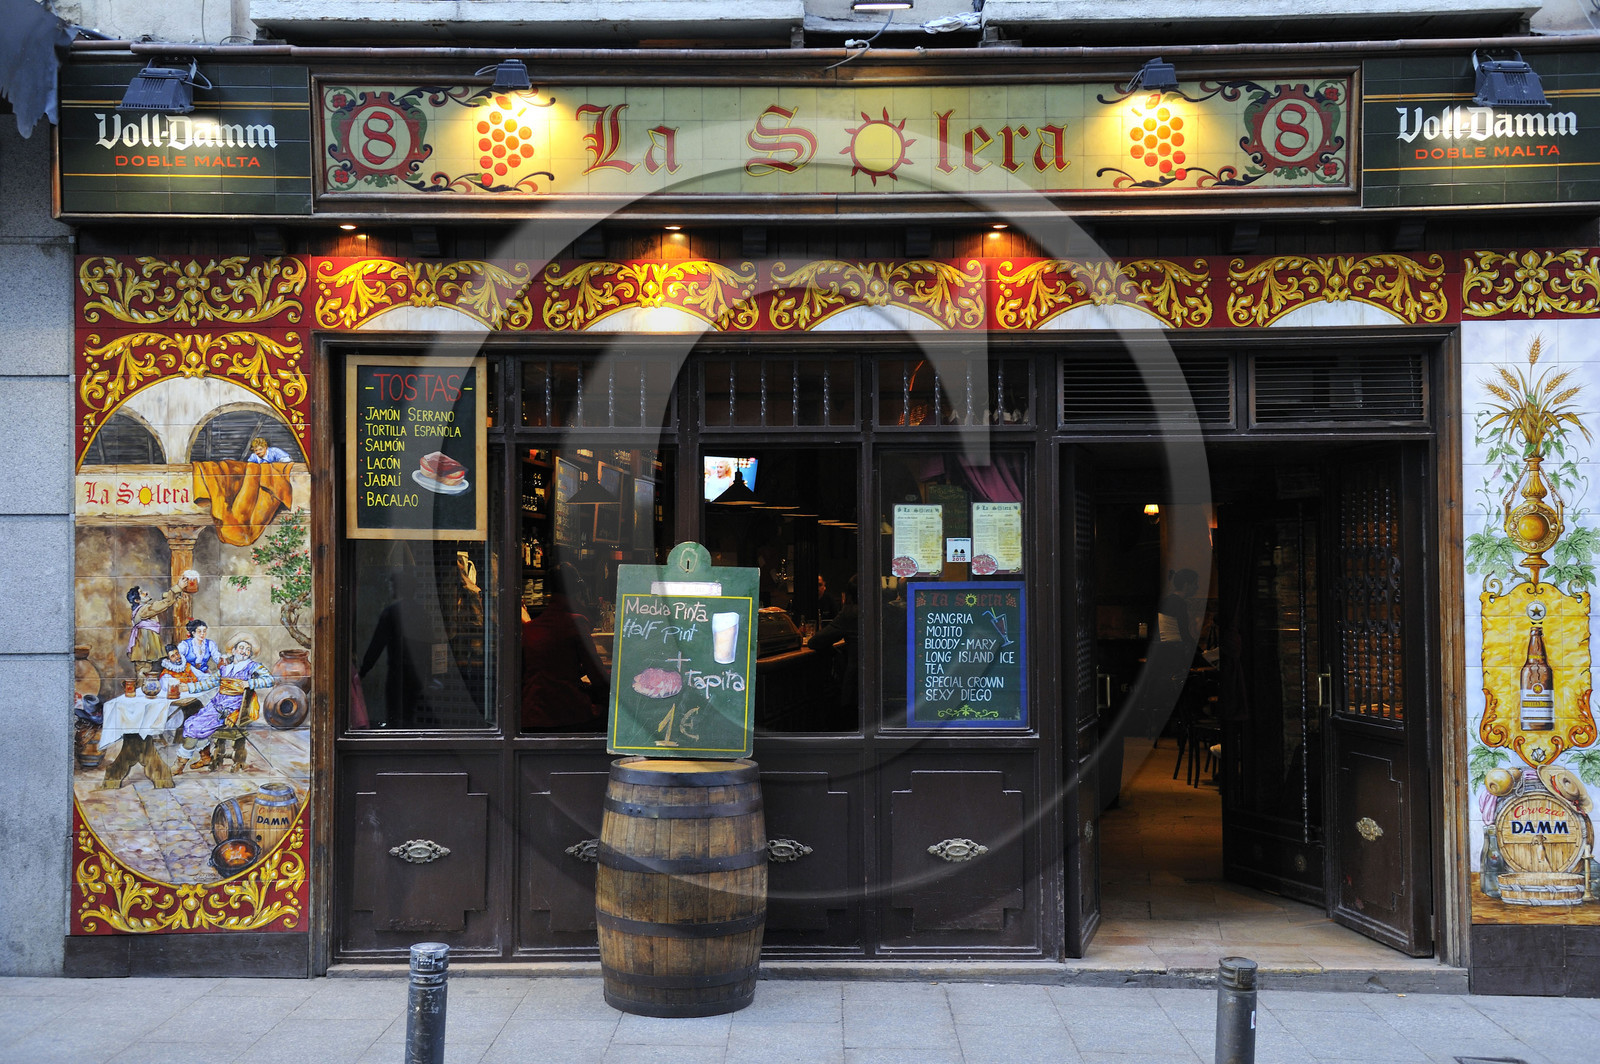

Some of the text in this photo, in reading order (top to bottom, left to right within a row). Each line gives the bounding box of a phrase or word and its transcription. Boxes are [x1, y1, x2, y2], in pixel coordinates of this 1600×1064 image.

[94, 112, 278, 151] Voll-Damm
[1275, 103, 1309, 158] 8
[1396, 105, 1579, 144] Voll-Damm
[362, 111, 396, 165] 8
[575, 103, 682, 176] La
[1415, 145, 1561, 160] DOBLE MALTA
[115, 155, 261, 168] DOBLE MALTA
[373, 373, 462, 402] TOSTAS
[365, 406, 455, 423] JAMÓN SERRANO
[365, 423, 462, 438] TORTILLA ESPAÑOLA
[365, 438, 405, 452] SALMÓN
[367, 455, 400, 470] LACÓN
[84, 481, 109, 504] La
[366, 491, 419, 507] BACALAO
[625, 596, 671, 616] Media
[927, 612, 974, 625] SANGRIA
[926, 625, 963, 638] MOJITO
[925, 651, 1015, 664] LONG ISLAND ICE
[925, 663, 945, 675] TEA
[925, 676, 1004, 689] SPECIAL CROWN
[925, 688, 992, 702] SEXY DIEGO
[256, 815, 290, 826] DAMM
[1511, 820, 1570, 834] DAMM
